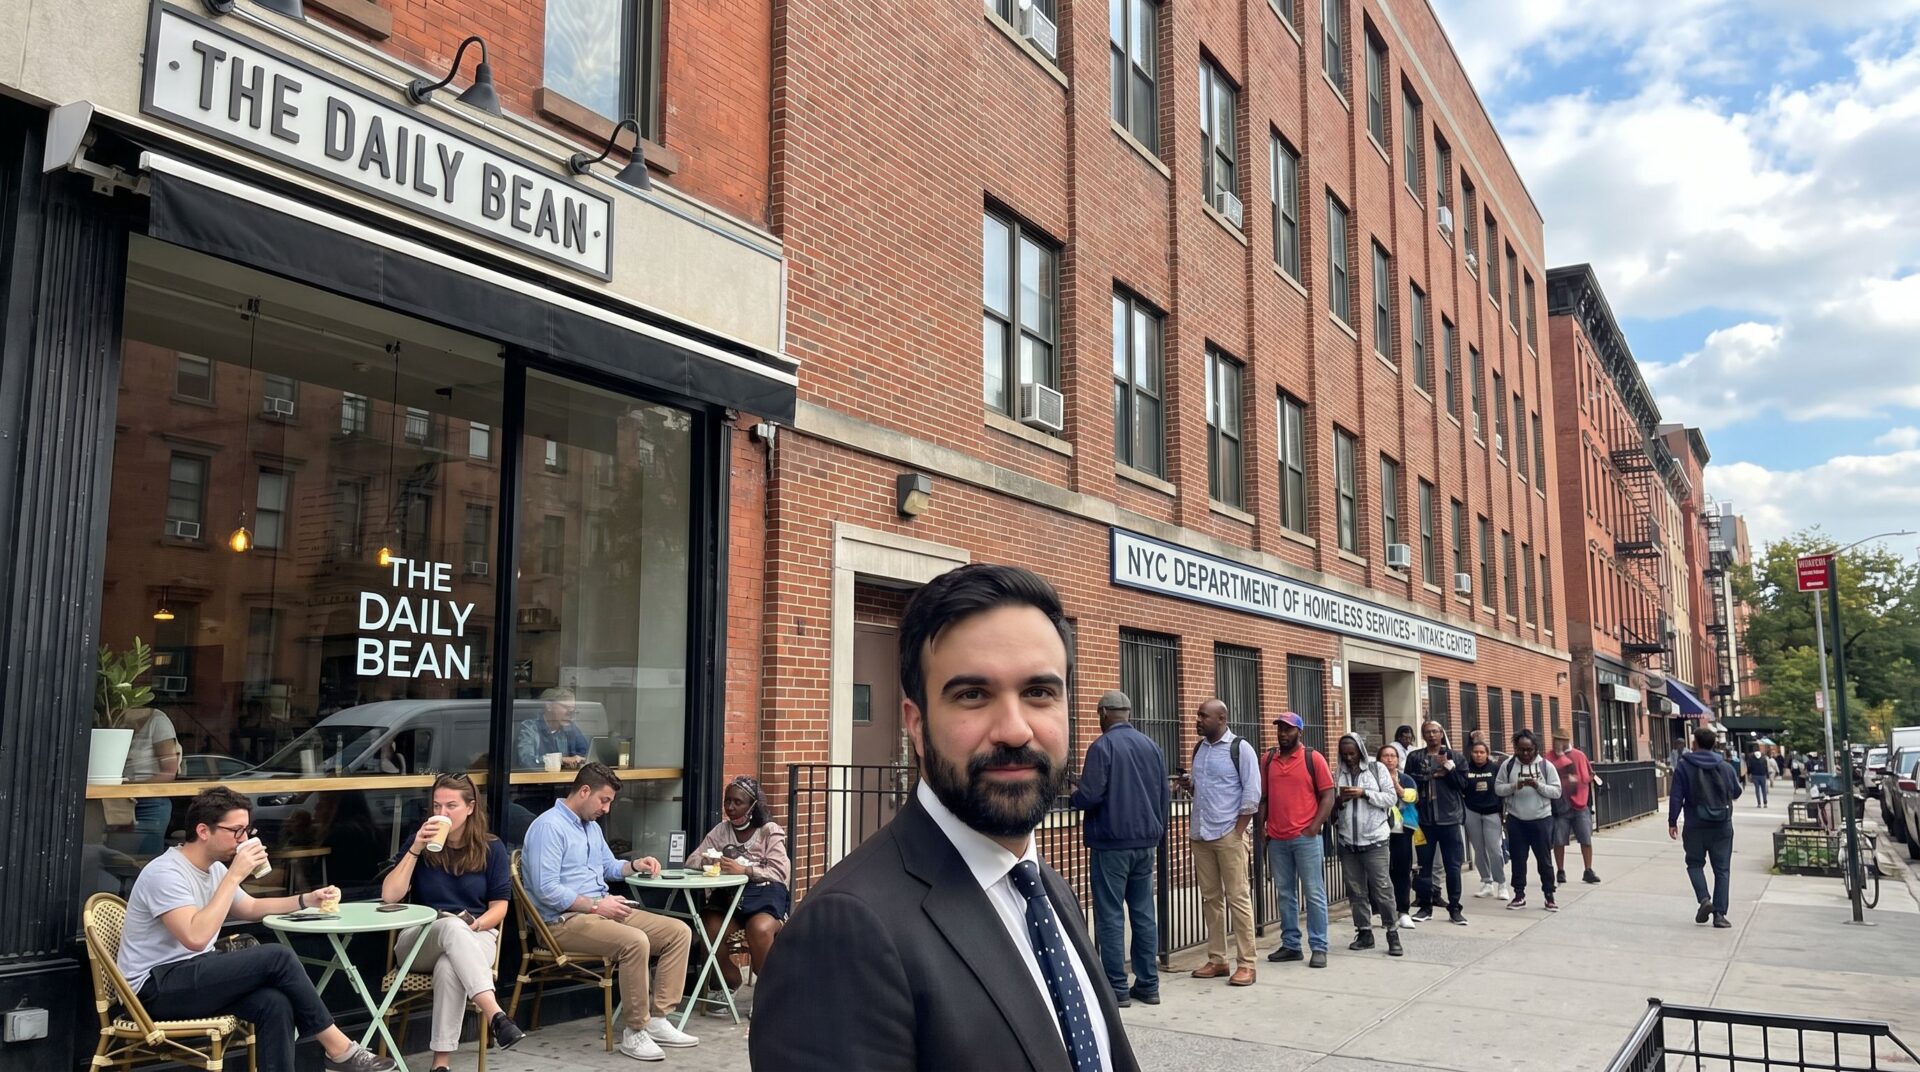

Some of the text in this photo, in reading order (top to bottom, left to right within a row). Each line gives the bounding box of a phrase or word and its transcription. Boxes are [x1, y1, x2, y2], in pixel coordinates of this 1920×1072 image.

[193, 40, 587, 254] THE DAILY BEAN
[387, 556, 452, 592] THE
[359, 591, 475, 637] DAILY
[1128, 545, 1168, 583] NYC
[1174, 557, 1279, 609] DEPARTMENT
[1283, 588, 1300, 613] OF
[1304, 593, 1363, 629] HOMELESS
[1366, 610, 1411, 641] SERVICES
[1417, 624, 1445, 649] INTAKE
[1446, 633, 1473, 656] CENTER
[356, 637, 471, 680] BEAN
